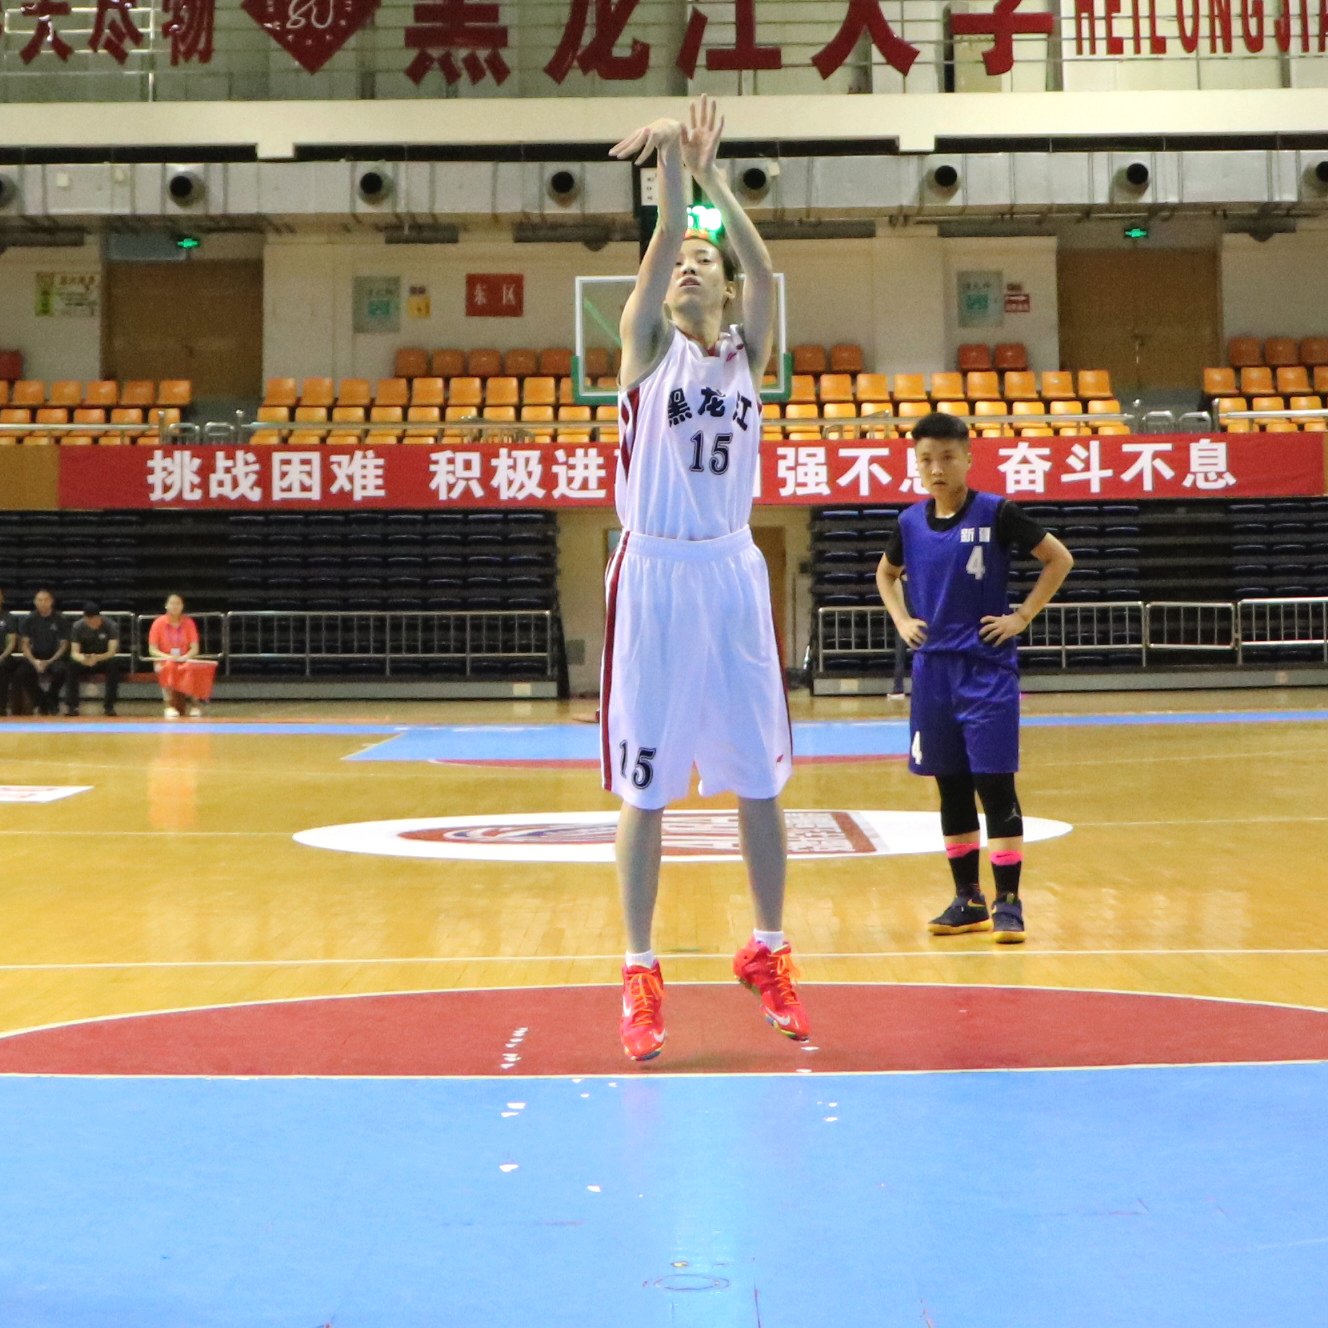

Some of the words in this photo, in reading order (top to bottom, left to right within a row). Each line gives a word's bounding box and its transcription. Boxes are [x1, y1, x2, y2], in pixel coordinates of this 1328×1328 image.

[665, 386, 752, 432] 黑龙江
[147, 449, 386, 502] 挑战困难
[428, 447, 621, 501] 积极进
[752, 445, 930, 498] 强不
[998, 439, 1236, 494] 奋斗不息
[689, 430, 733, 475] 15
[965, 545, 985, 580] 4
[618, 737, 657, 789] 15
[911, 730, 922, 765] 4
